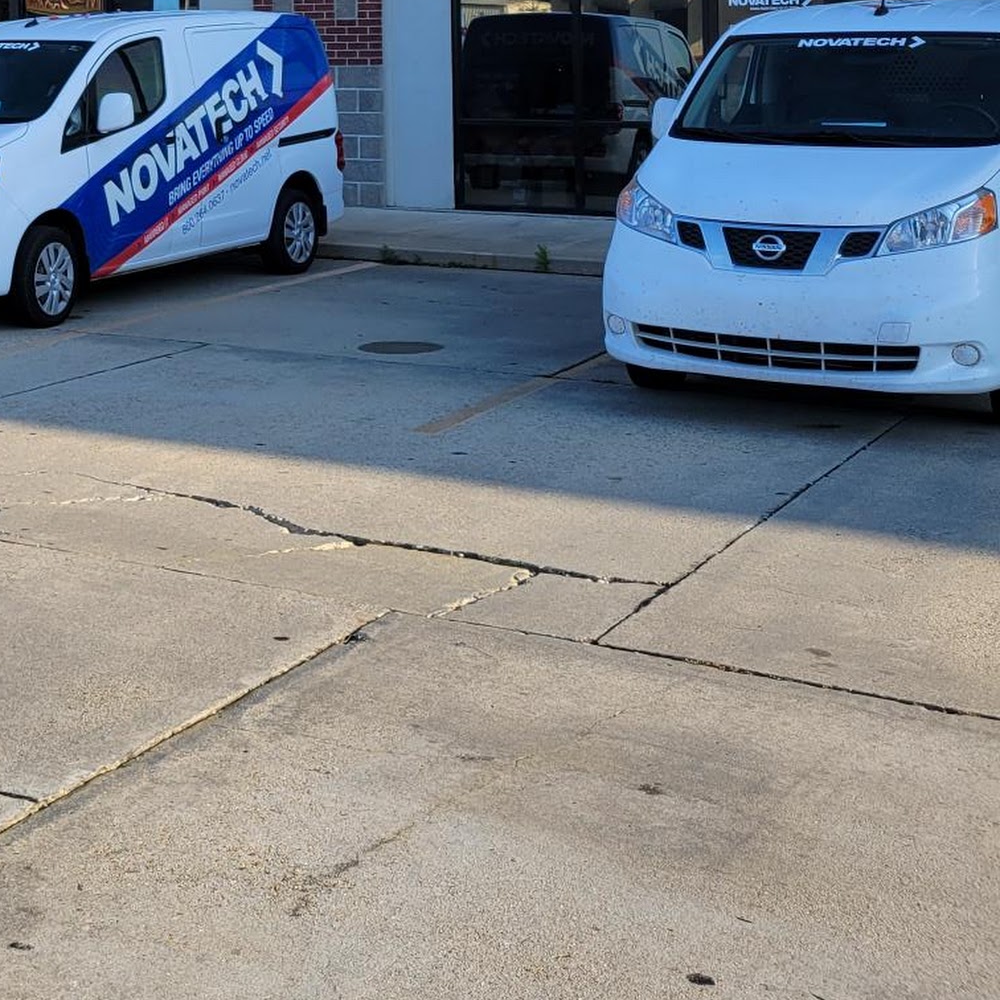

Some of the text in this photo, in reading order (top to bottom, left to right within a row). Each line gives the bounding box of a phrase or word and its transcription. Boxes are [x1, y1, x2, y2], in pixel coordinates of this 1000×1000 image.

[797, 37, 907, 48] NOVATECH
[103, 60, 269, 227] NOVATECH
[168, 106, 275, 206] BRING EVERYTHING UP TO SPEED
